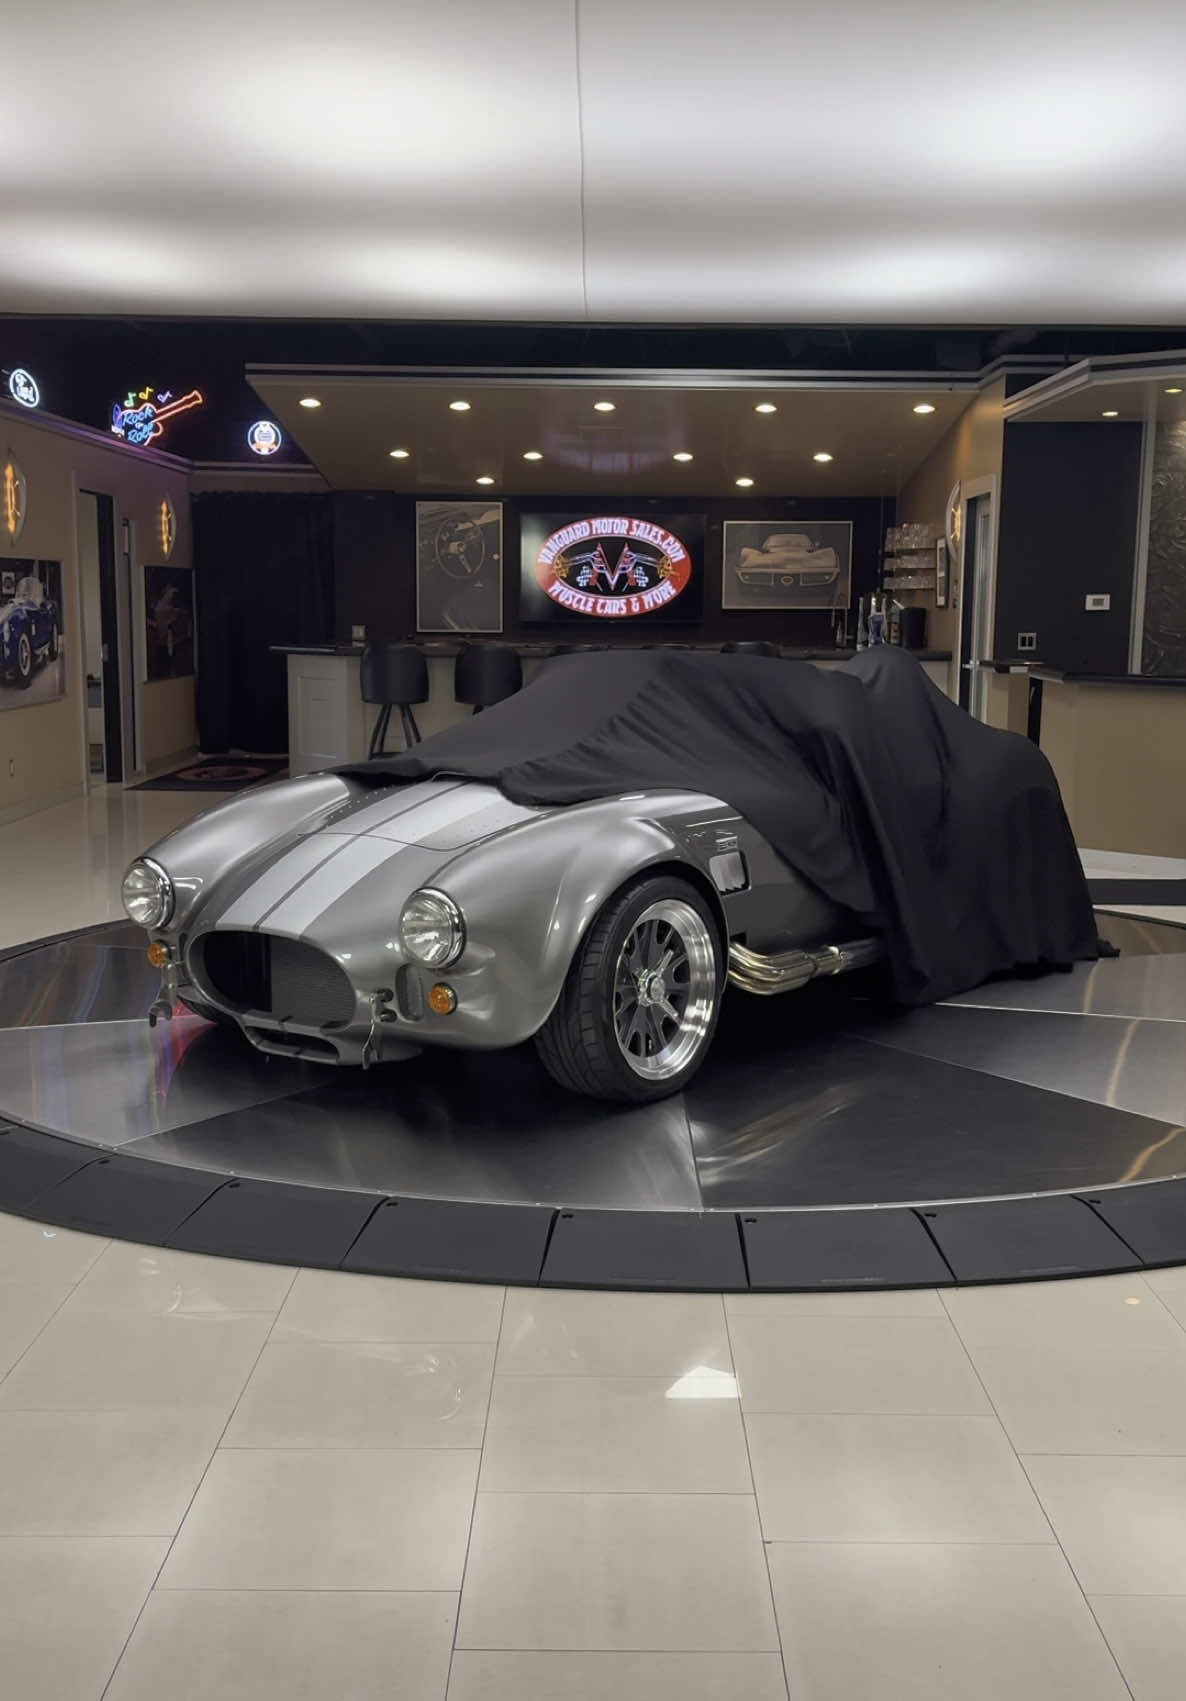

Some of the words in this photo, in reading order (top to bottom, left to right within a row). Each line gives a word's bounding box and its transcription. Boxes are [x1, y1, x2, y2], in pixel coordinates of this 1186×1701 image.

[122, 406, 152, 426] Rock
[127, 422, 153, 443] Roll
[539, 522, 590, 564] VANGUARD
[591, 518, 629, 535] MOTOR
[548, 580, 594, 612] MUSCLE
[596, 598, 627, 615] CARS
[632, 597, 639, 612] &
[643, 581, 677, 610] MORE
